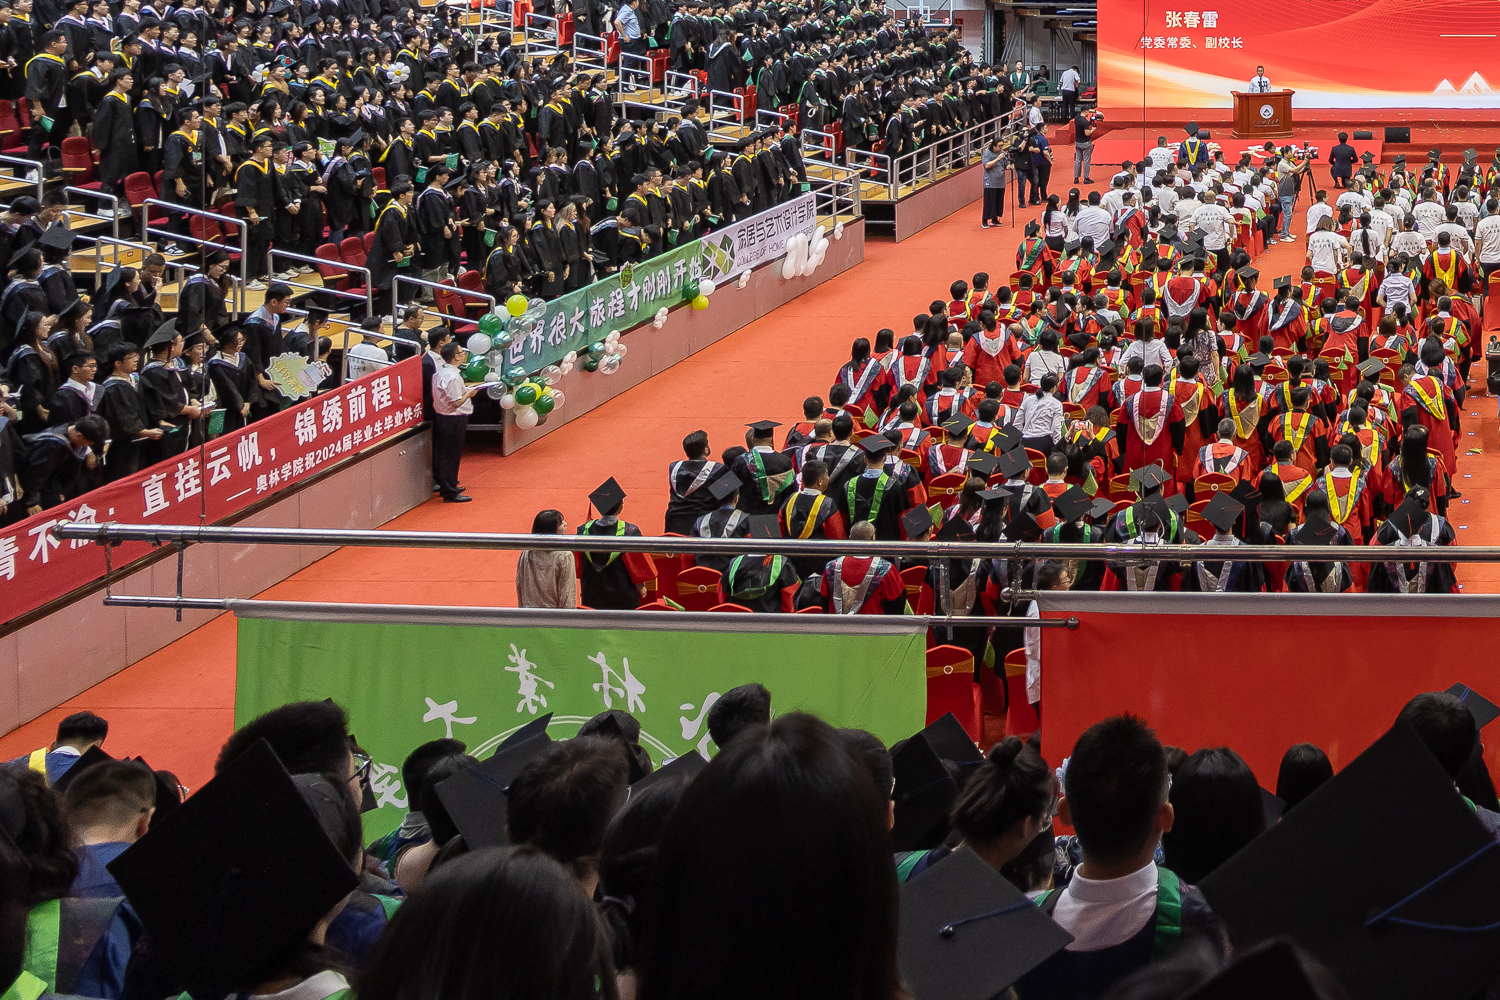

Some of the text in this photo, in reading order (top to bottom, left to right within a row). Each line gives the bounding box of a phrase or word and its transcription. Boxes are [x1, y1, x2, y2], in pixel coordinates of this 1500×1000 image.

[1165, 10, 1219, 29] 张春雷
[1140, 36, 1244, 49] 党委常委、副校长
[738, 199, 815, 251] 家居与艺术设计学院
[509, 256, 703, 364] 世界很大旅程才刚刚开始
